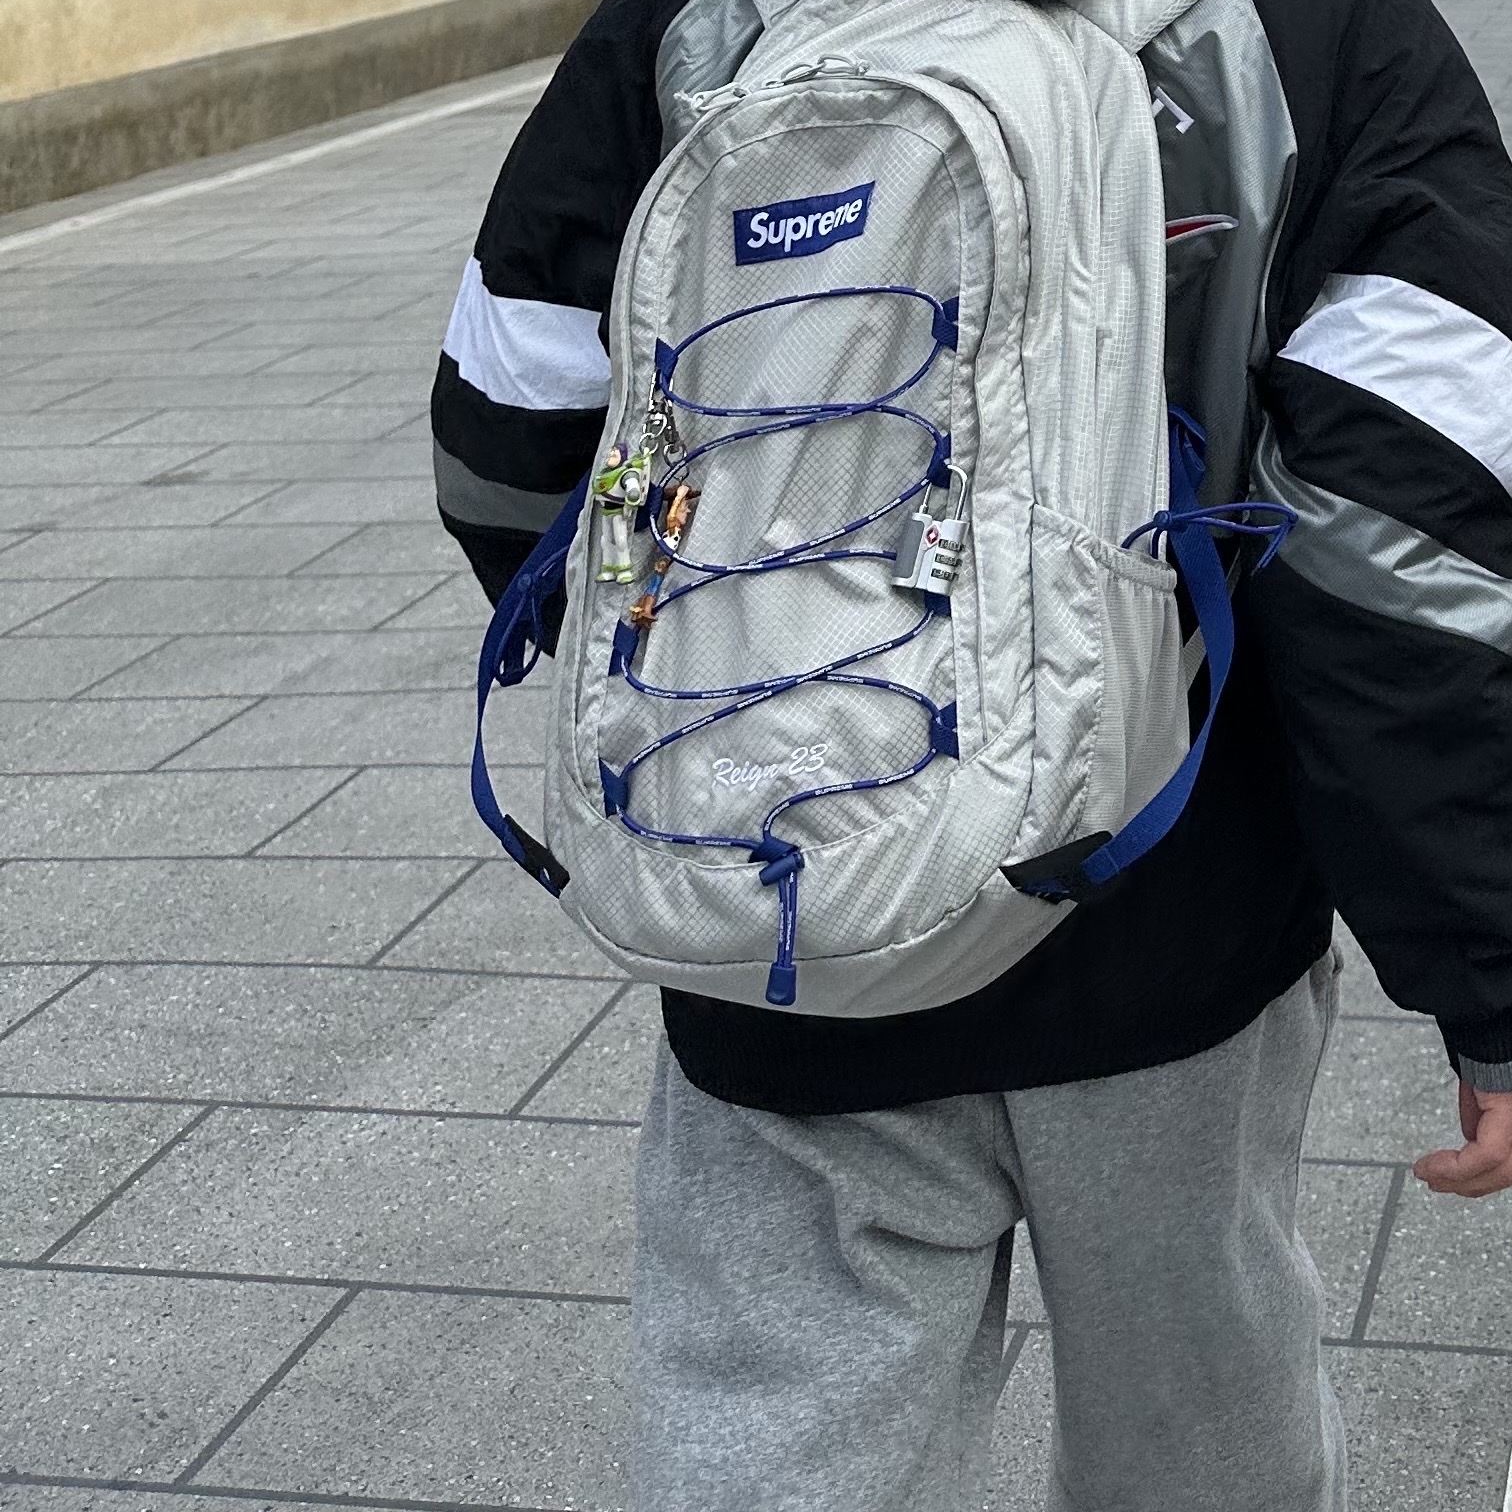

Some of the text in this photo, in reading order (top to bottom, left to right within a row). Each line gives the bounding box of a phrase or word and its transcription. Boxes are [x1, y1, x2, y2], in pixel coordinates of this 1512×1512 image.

[746, 198, 863, 253] Supreme
[712, 743, 829, 791] Reign 23
